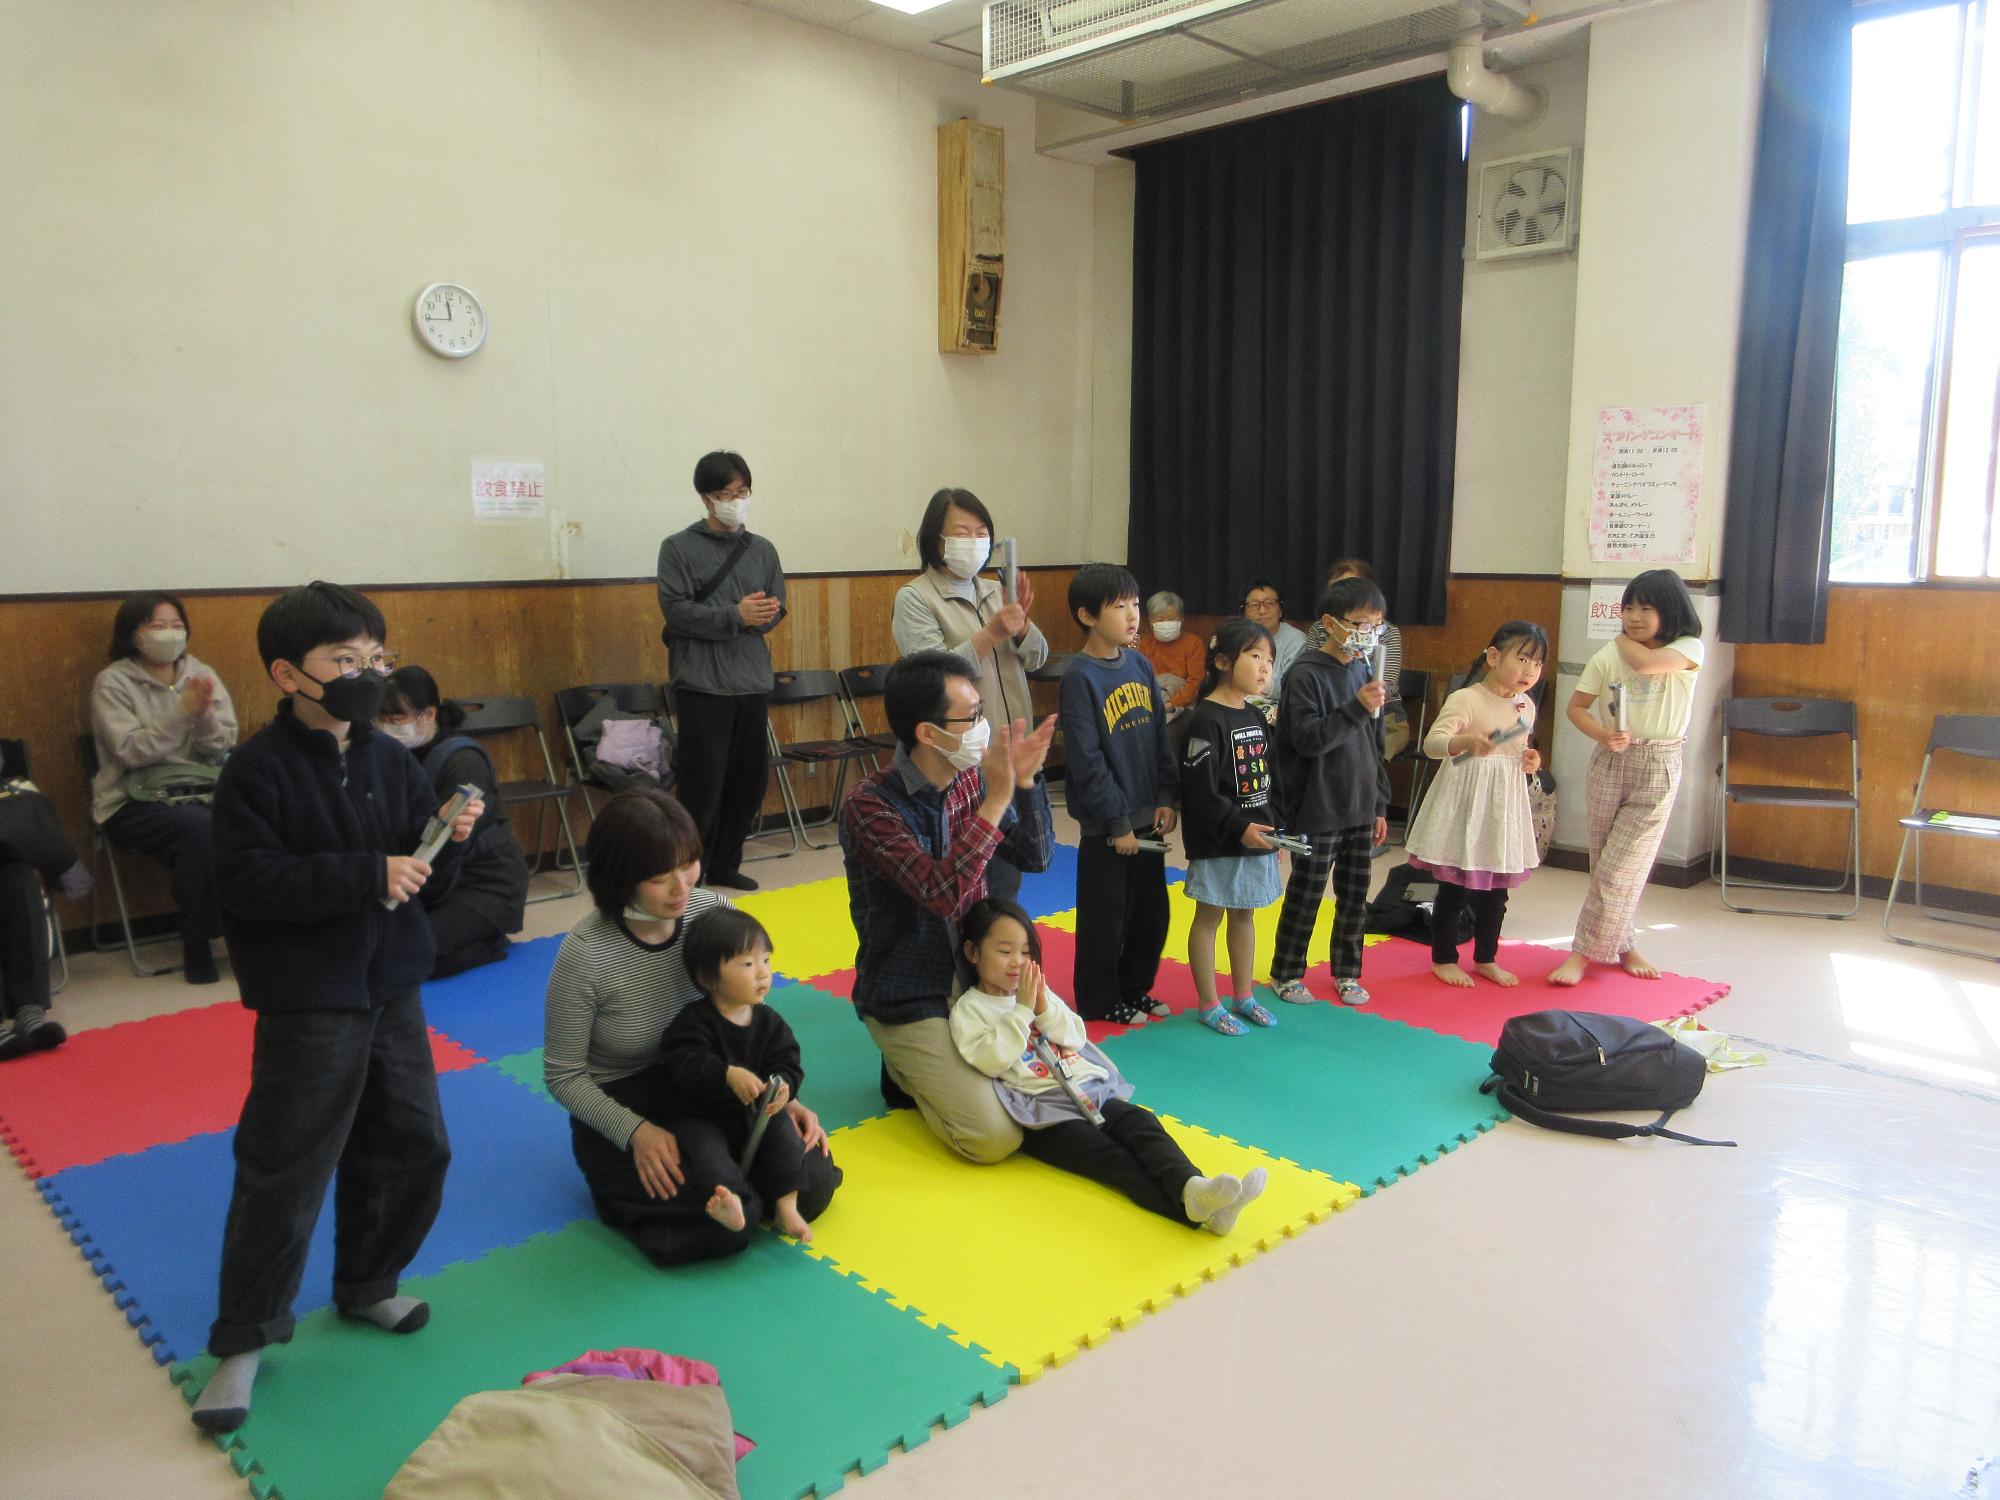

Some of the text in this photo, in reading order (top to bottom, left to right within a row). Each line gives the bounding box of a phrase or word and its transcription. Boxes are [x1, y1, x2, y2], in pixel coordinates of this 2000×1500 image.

[465, 304, 472, 314] 2
[475, 479, 544, 498] 飲食禁止
[1590, 601, 1623, 620] 飲食
[1103, 681, 1153, 735] MICHIGA
[1241, 781, 1250, 793] 2
